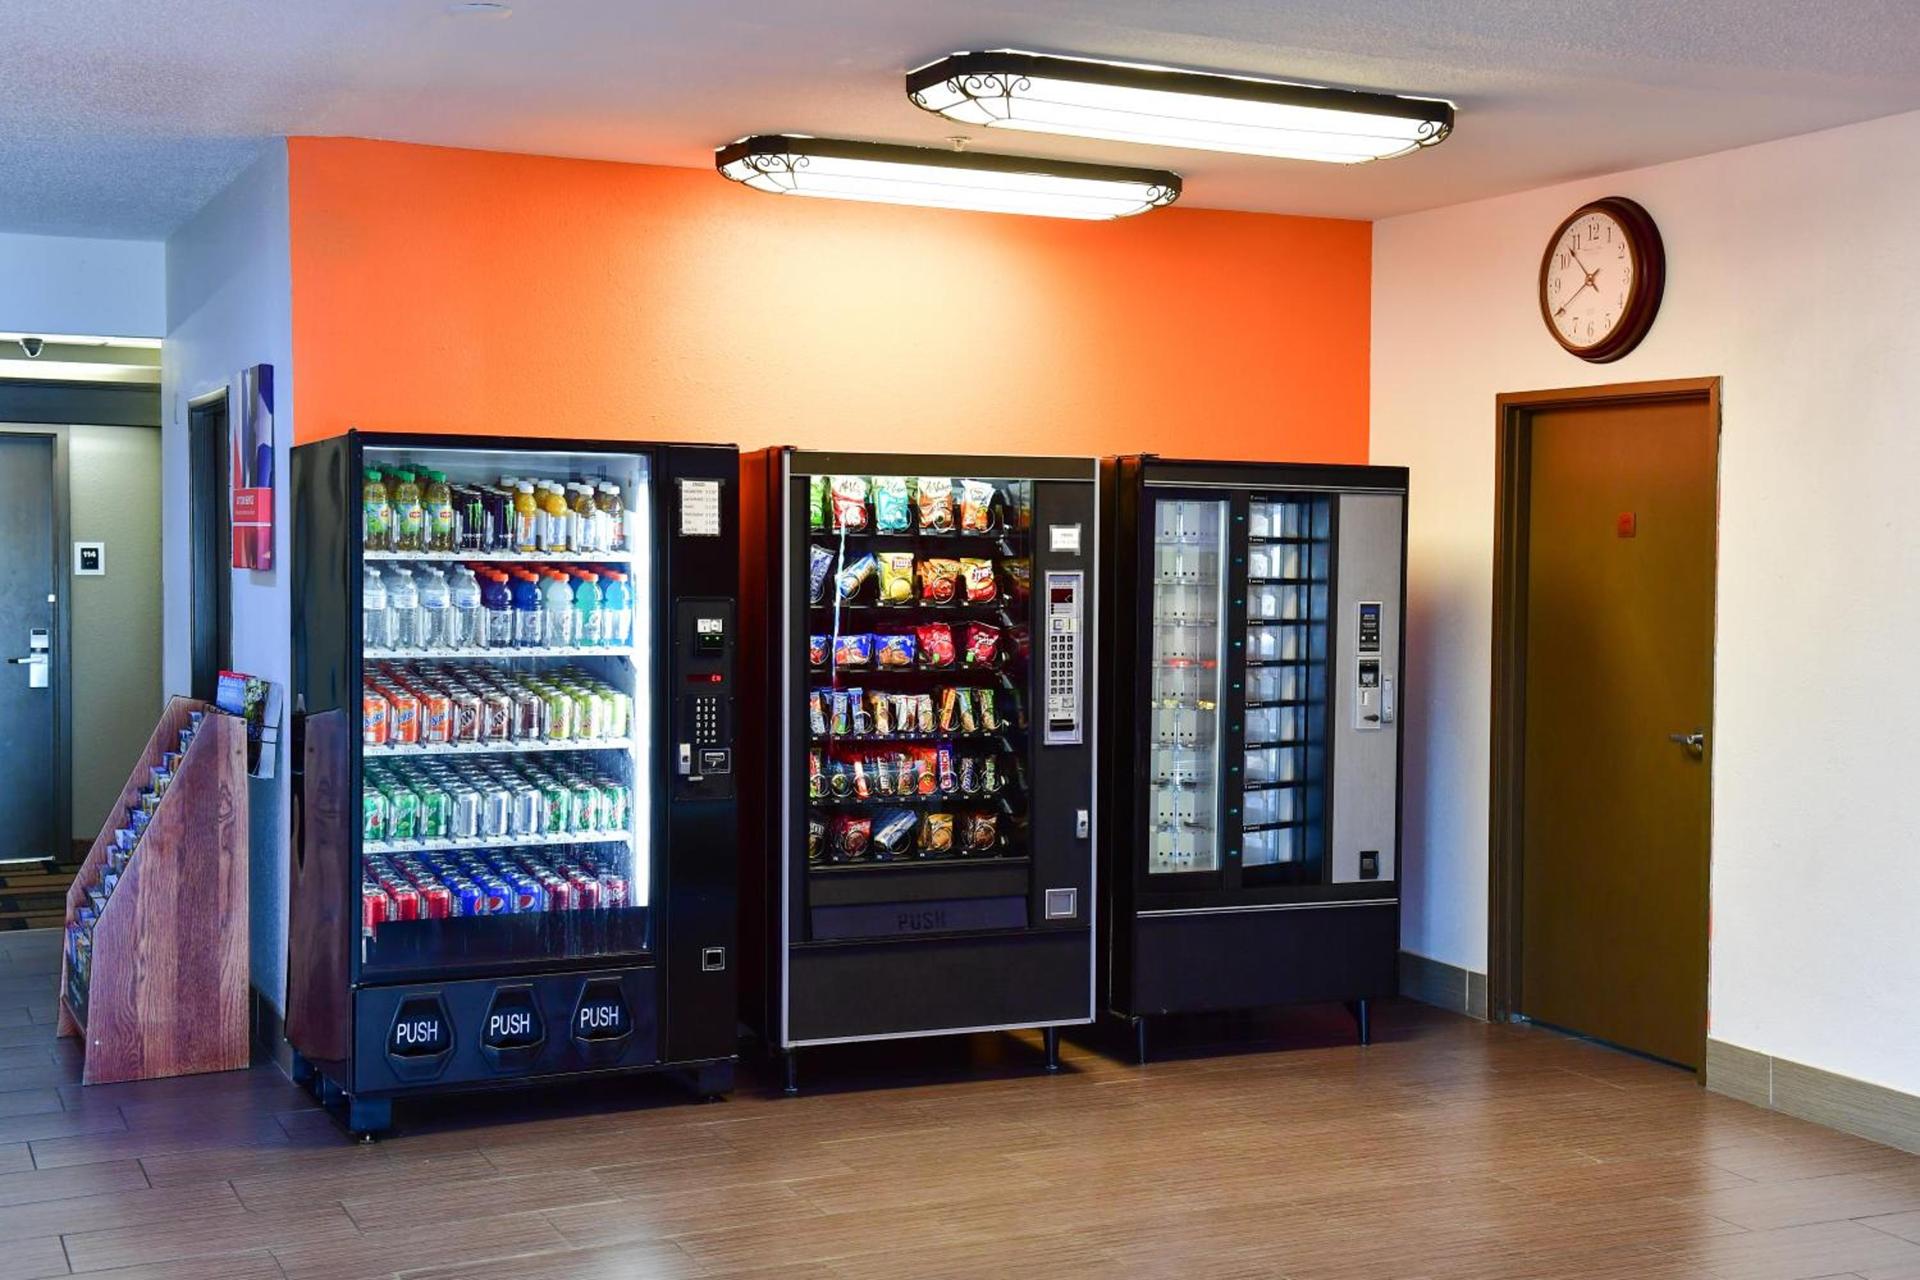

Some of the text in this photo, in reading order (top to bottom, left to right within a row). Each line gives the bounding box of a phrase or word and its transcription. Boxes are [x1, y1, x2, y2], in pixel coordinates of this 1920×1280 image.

[1572, 223, 1612, 250] 11 12 1
[1560, 242, 1626, 270] 10 2
[1553, 267, 1630, 293] 9 3
[1572, 316, 1579, 334] 7
[1586, 319, 1594, 338] 6
[898, 910, 945, 931] PUSH
[396, 1005, 620, 1045] PUSH PUSH PUSH
